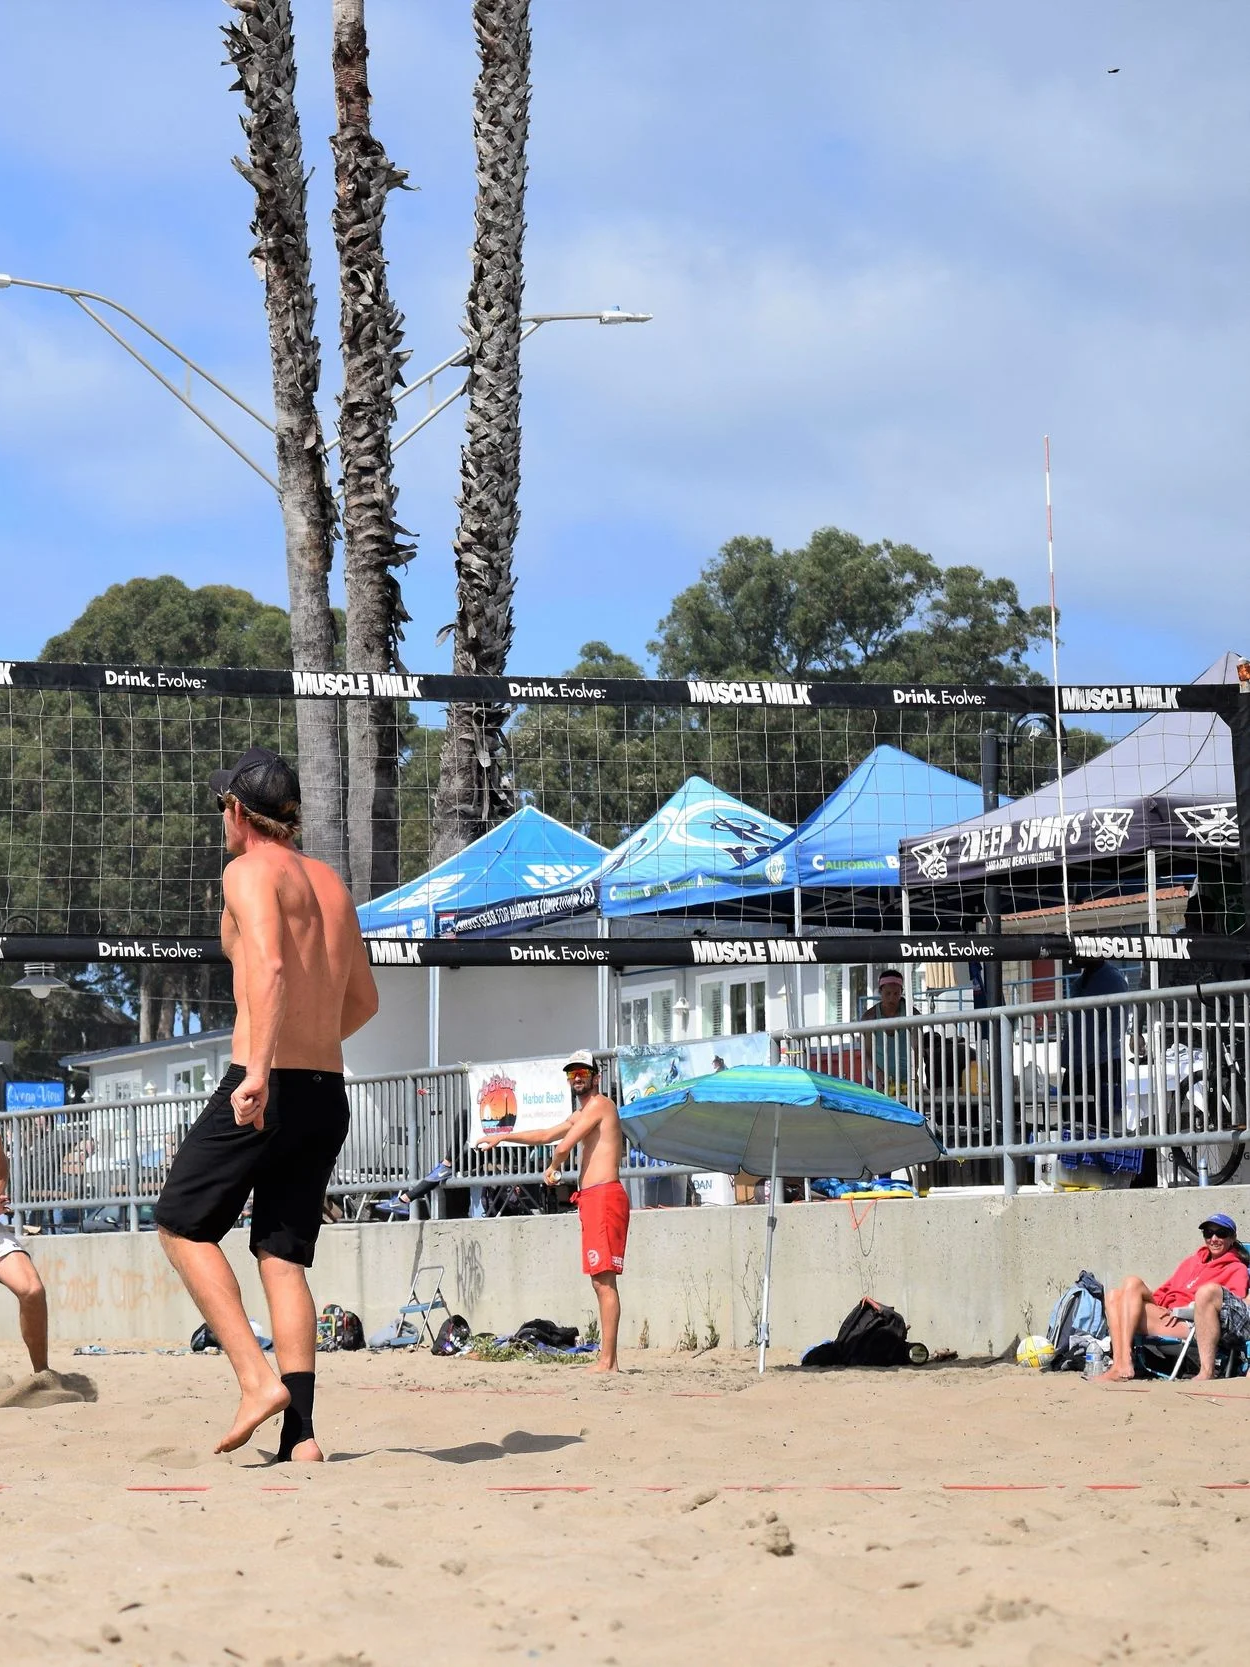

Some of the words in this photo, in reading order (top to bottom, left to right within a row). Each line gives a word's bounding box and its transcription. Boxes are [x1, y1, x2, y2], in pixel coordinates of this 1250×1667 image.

[292, 672, 369, 696] MUSCLE
[687, 682, 763, 704] MUSCLE
[1062, 688, 1132, 710] MUSCLE
[958, 824, 1013, 864] 2DEEP
[812, 854, 886, 871] CALIFORNIA
[691, 941, 766, 963] MUSCLE
[1075, 936, 1143, 958] MUSCLE
[522, 1093, 544, 1105] Harbor
[546, 1091, 565, 1103] Beach
